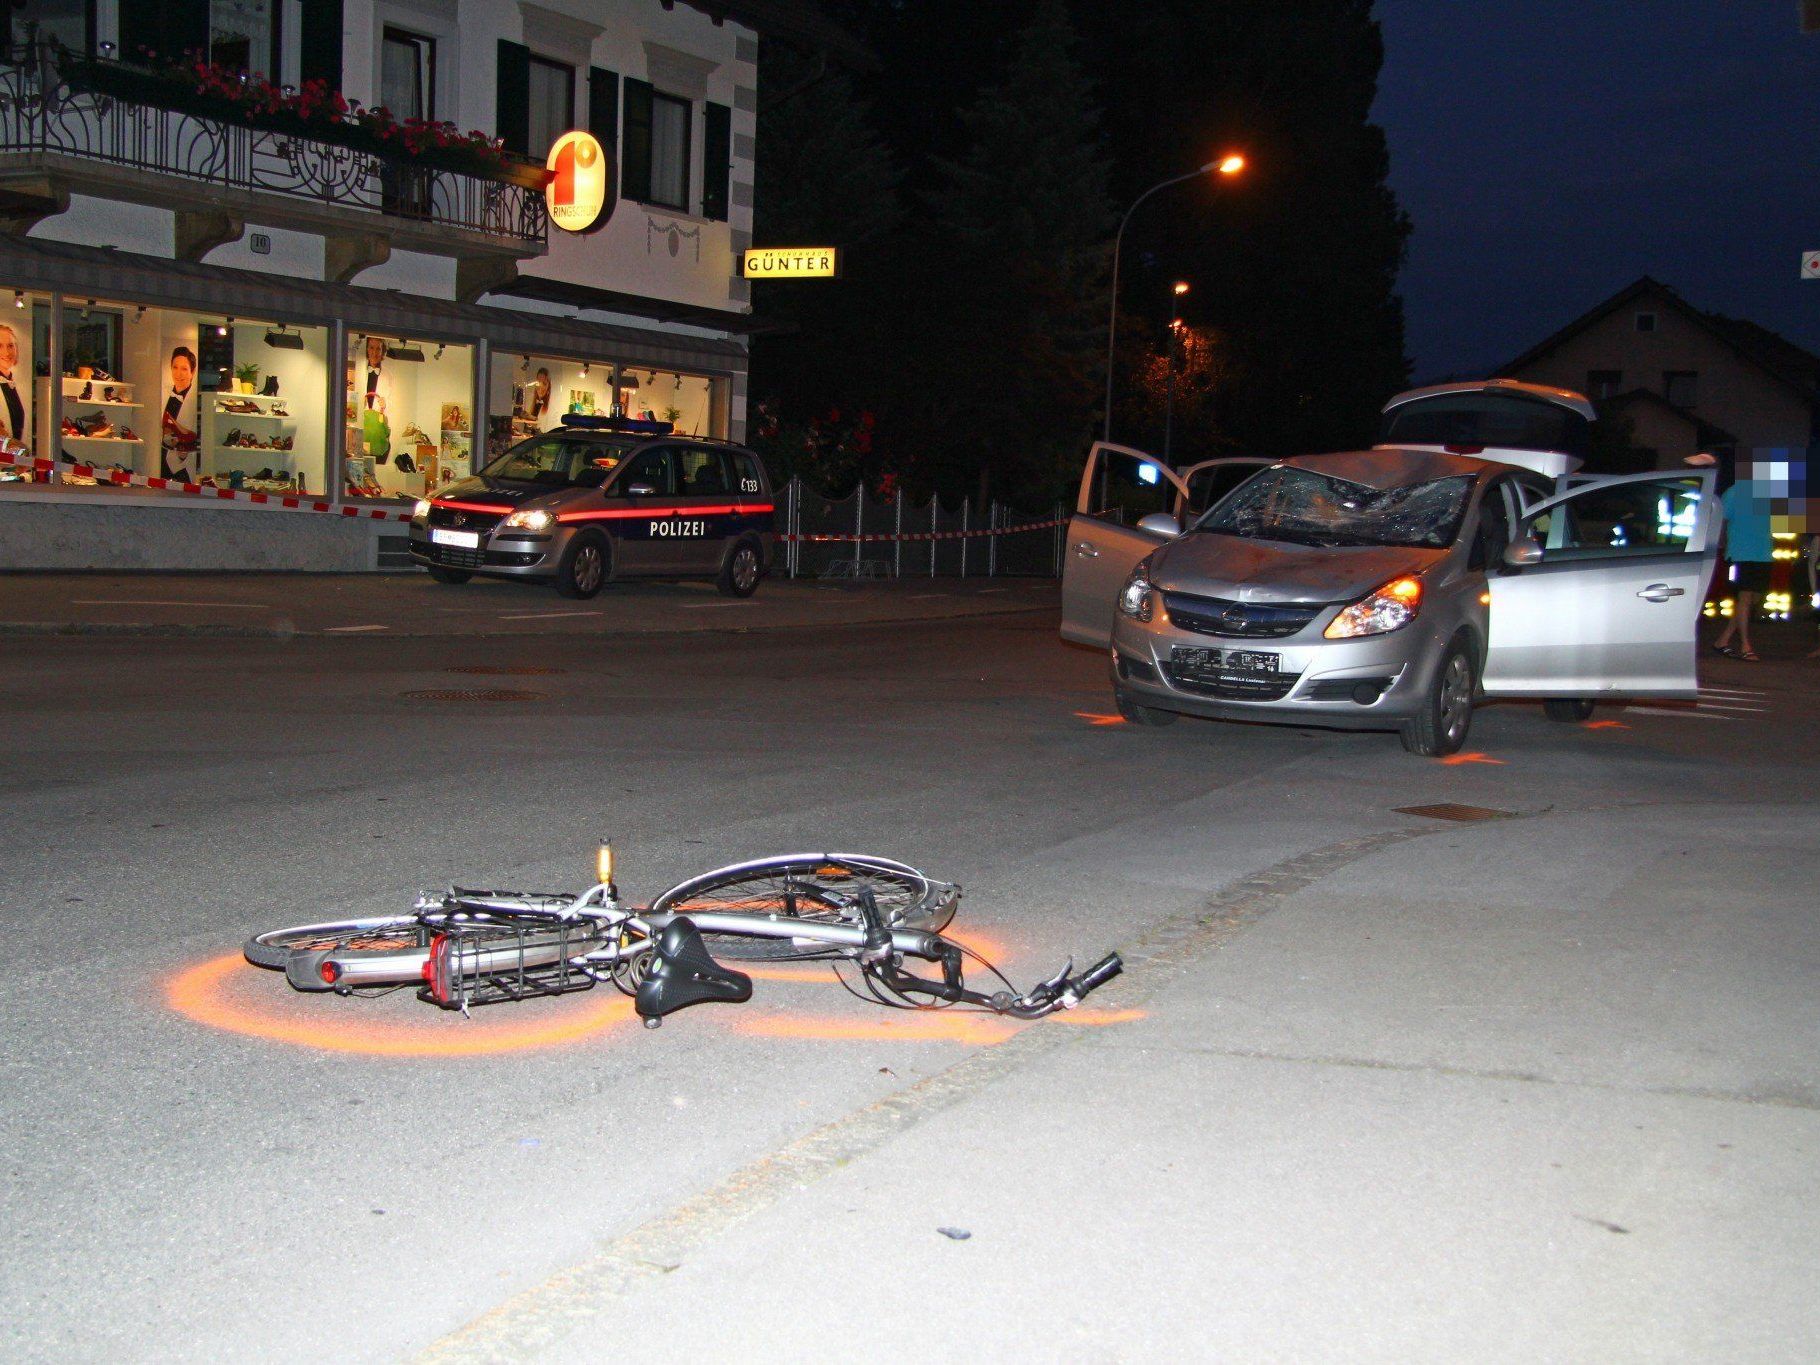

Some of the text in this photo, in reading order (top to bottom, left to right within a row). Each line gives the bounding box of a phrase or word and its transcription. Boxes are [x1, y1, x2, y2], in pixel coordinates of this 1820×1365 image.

[255, 236, 266, 247] 10
[747, 252, 830, 271] GÜNTER
[747, 479, 758, 492] 133
[650, 521, 705, 537] POLIZEI
